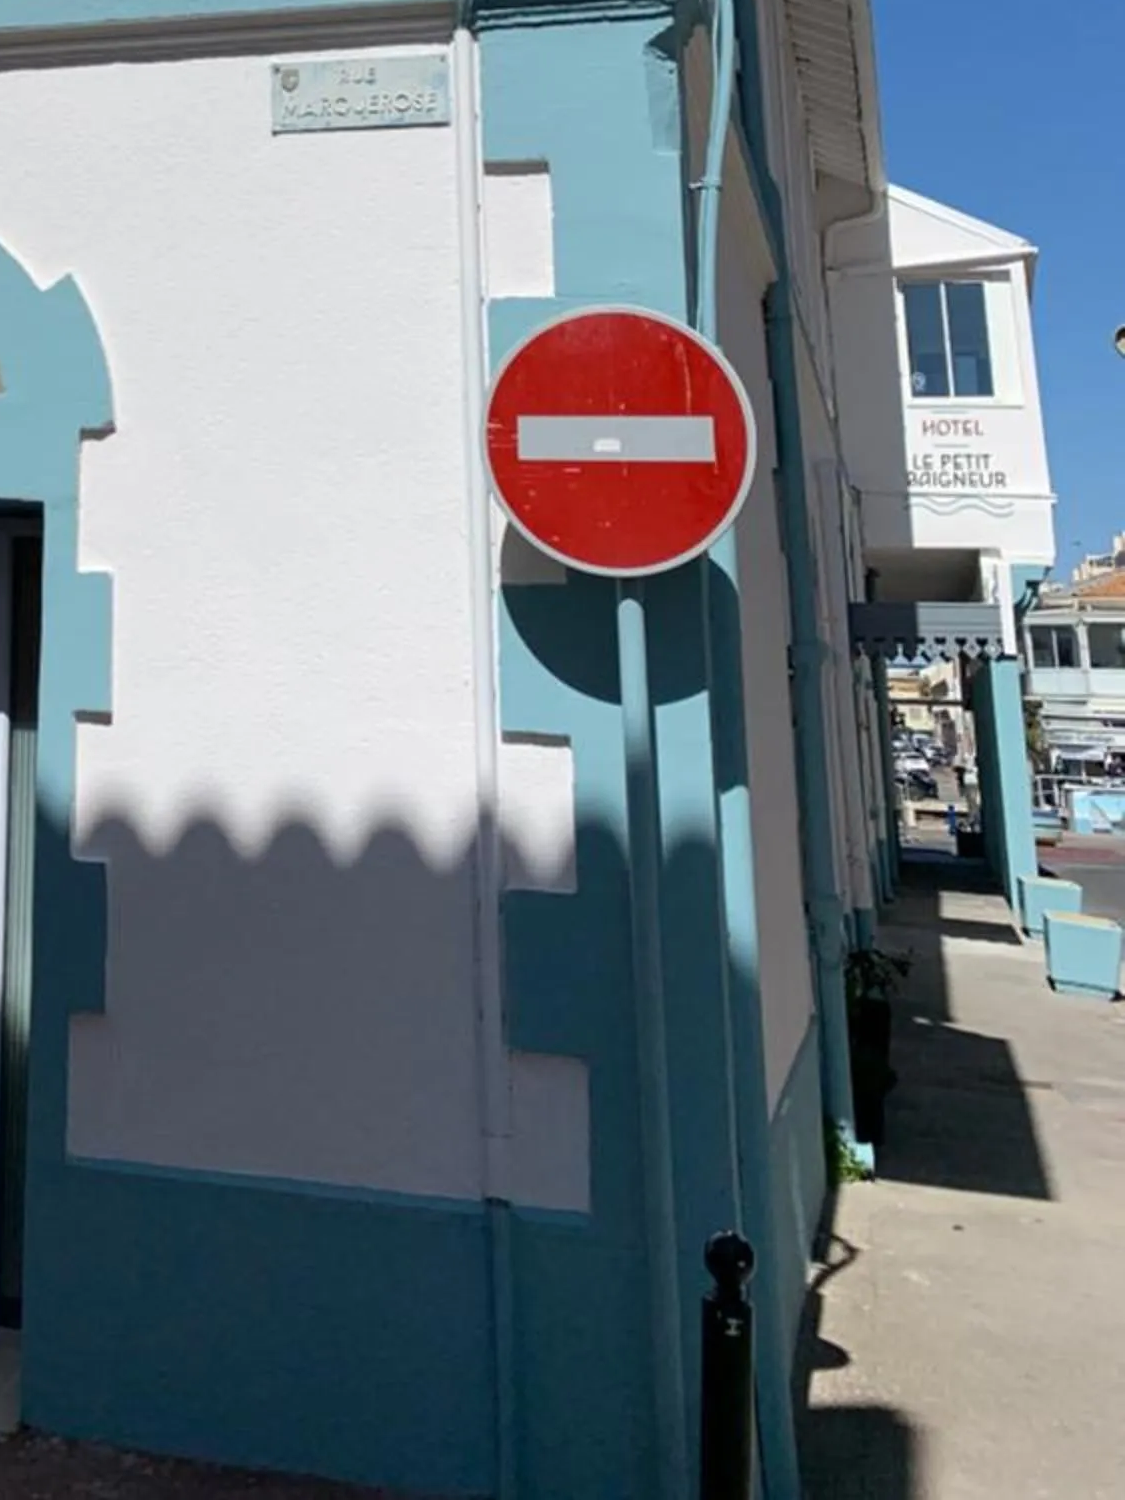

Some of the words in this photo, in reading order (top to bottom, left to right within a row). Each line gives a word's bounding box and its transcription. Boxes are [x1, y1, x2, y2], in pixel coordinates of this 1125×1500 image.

[338, 66, 377, 85] RUE
[922, 419, 984, 436] HOTEL
[912, 454, 934, 470] LE
[940, 453, 992, 470] PETIT
